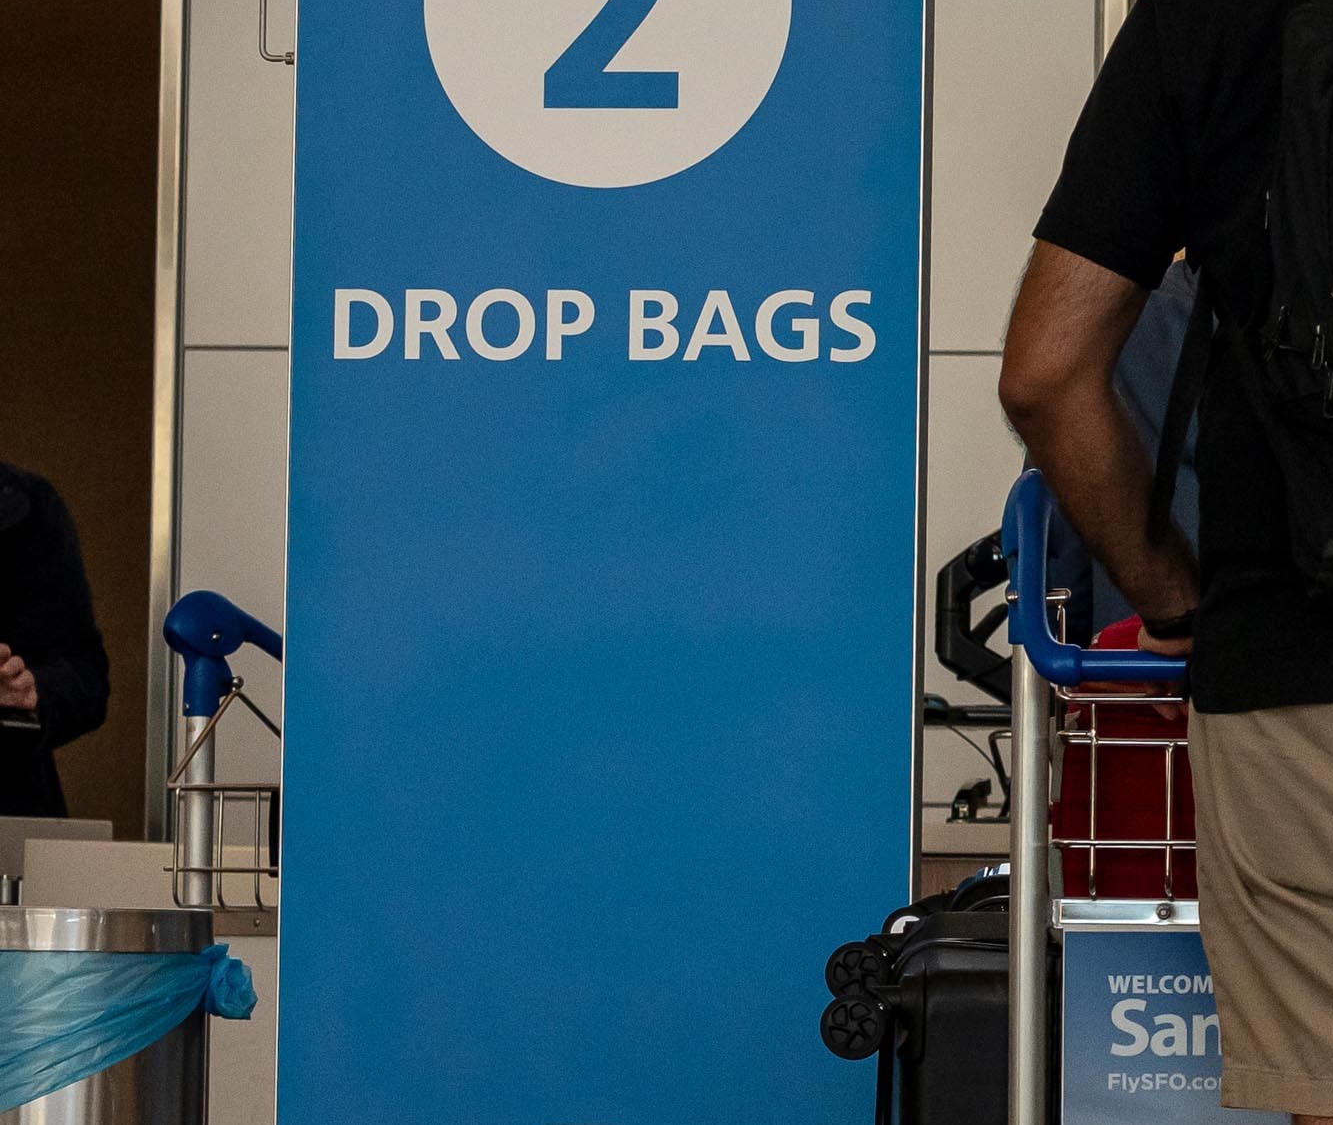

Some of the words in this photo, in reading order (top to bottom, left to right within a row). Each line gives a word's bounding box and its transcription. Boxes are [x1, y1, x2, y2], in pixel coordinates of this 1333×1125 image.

[332, 287, 597, 362] DROP
[627, 288, 878, 364] BAGS
[1107, 975, 1215, 995] WELCOM
[1107, 1073, 1222, 1093] FlySFO.co
